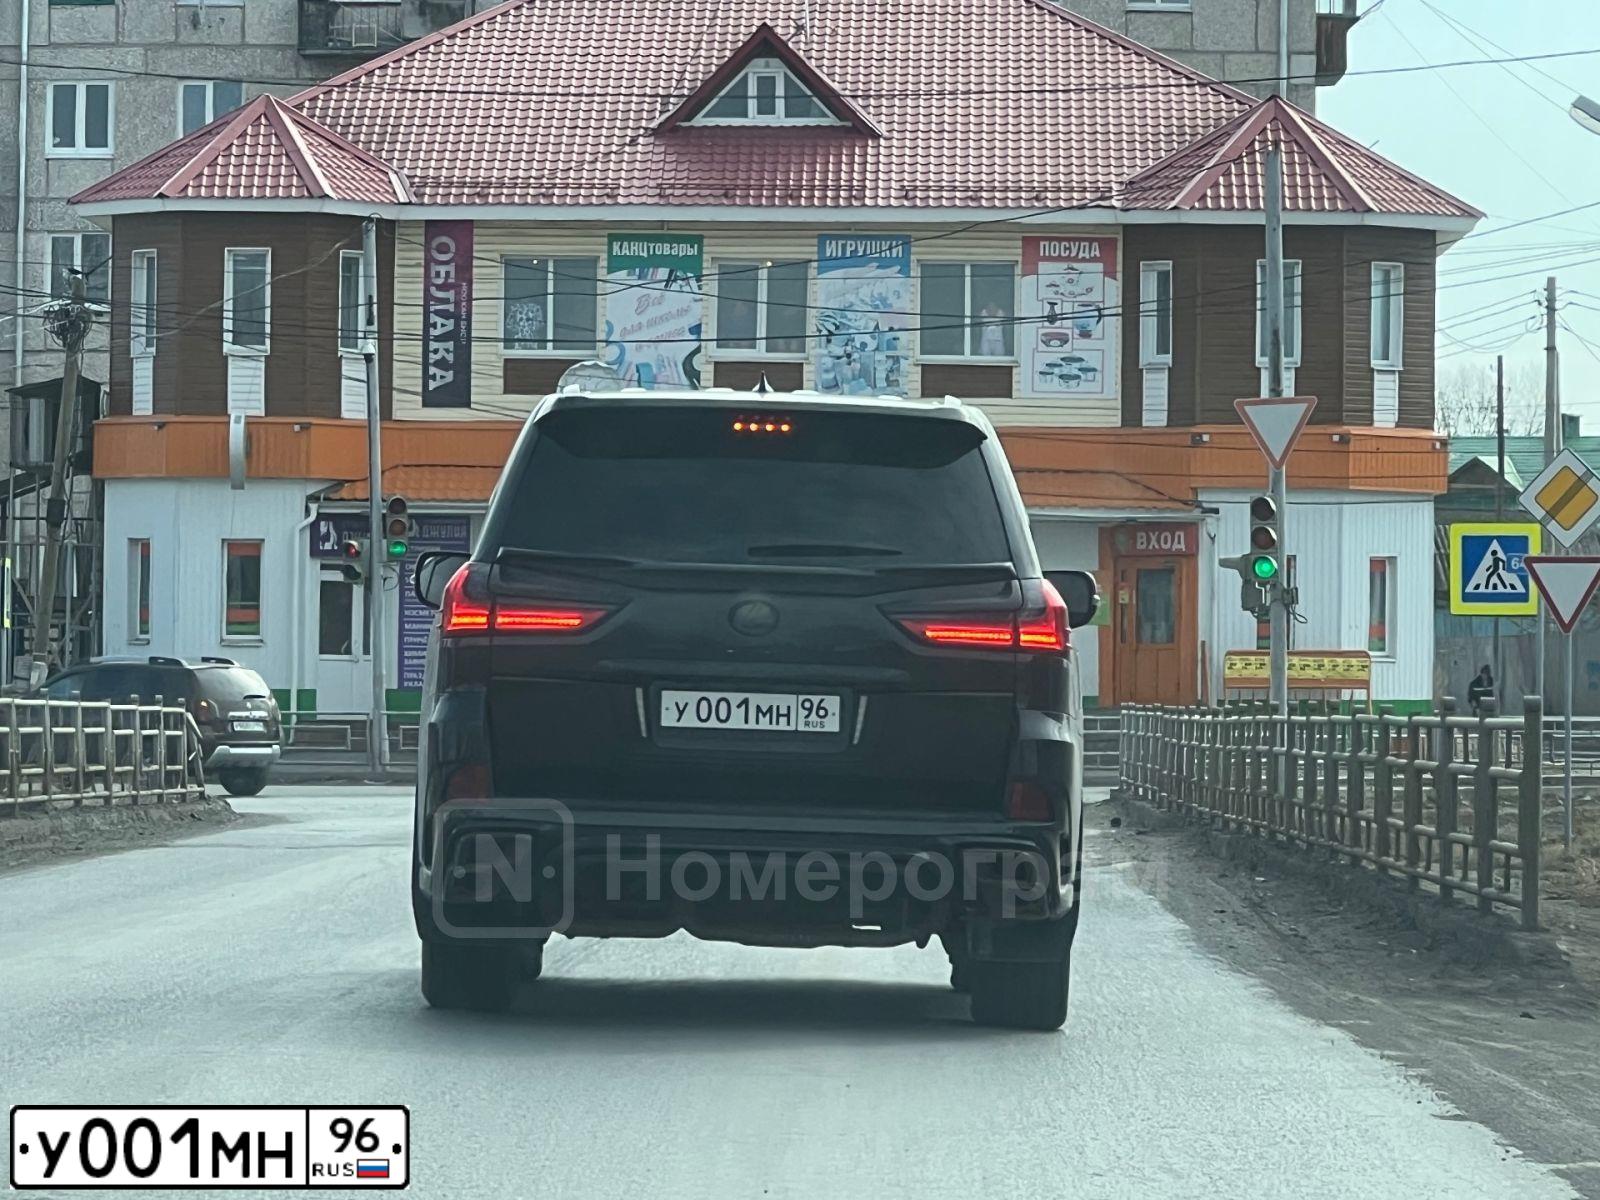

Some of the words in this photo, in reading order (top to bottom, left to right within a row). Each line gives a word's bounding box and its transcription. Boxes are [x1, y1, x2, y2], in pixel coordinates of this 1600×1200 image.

[825, 239, 903, 259] ИГРУШКИ
[1039, 240, 1101, 258] ПОСУДА
[428, 235, 456, 391] ОБЛАКА
[1136, 531, 1186, 552] ВХОД
[800, 697, 829, 720] 96
[804, 720, 826, 729] RUS
